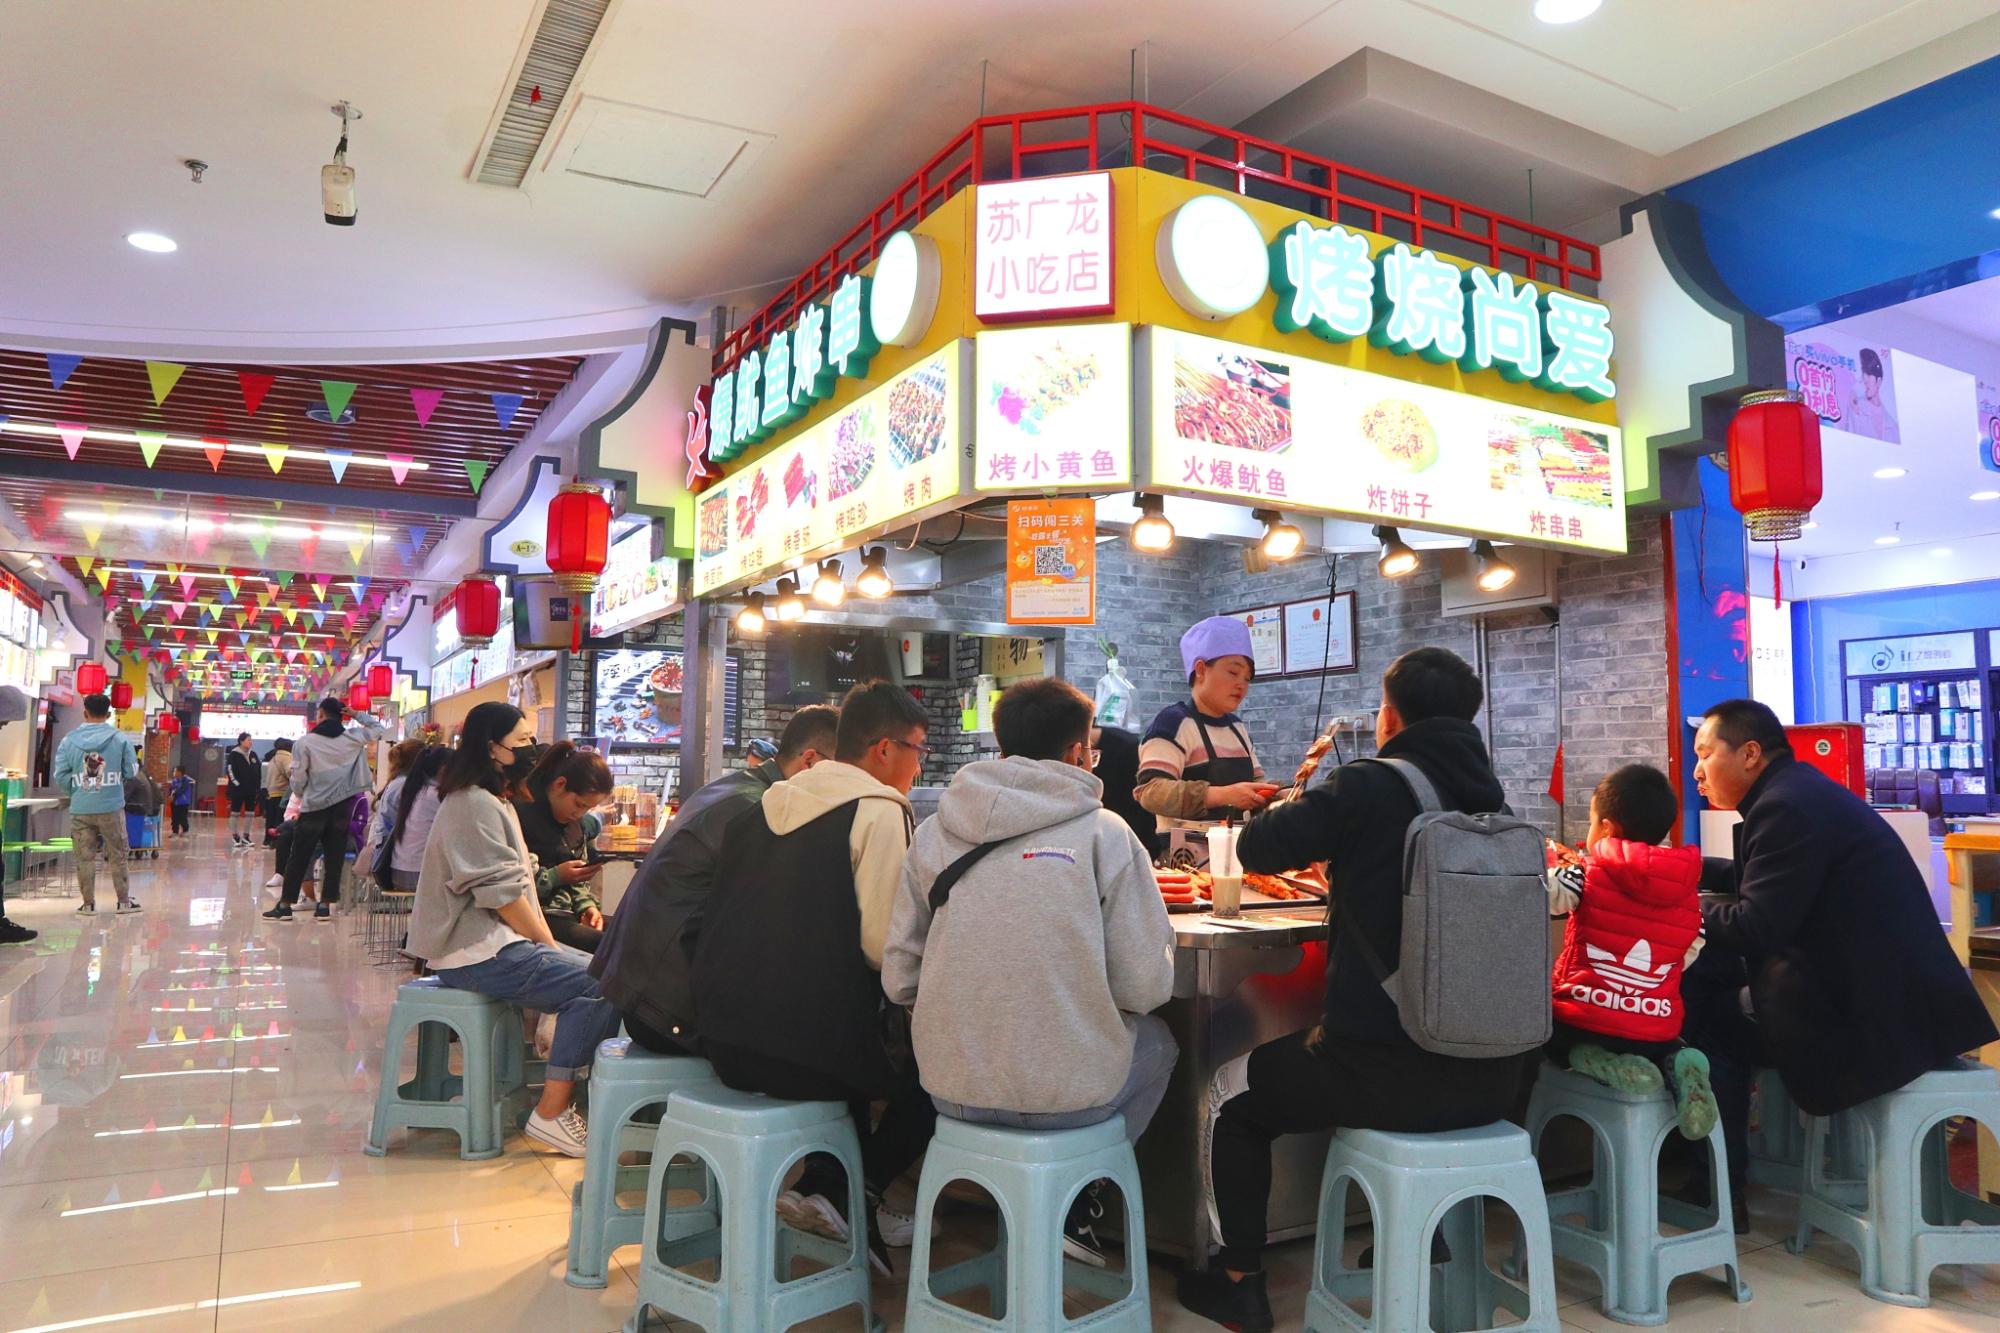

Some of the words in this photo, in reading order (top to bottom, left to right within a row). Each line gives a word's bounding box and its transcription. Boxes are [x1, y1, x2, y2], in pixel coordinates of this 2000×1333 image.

[986, 192, 1099, 244] 苏广龙
[986, 249, 1099, 299] 小吃店
[1285, 220, 1616, 398] 烤烧尚爱
[989, 449, 1117, 482] 烤小黄鱼
[1182, 455, 1288, 497] 火爆鱿鱼
[1367, 484, 1433, 519] 炸饼子
[1017, 514, 1084, 528] 扫码闯三关
[1529, 510, 1583, 540] 炸串串
[1571, 984, 1672, 1018] adidas
